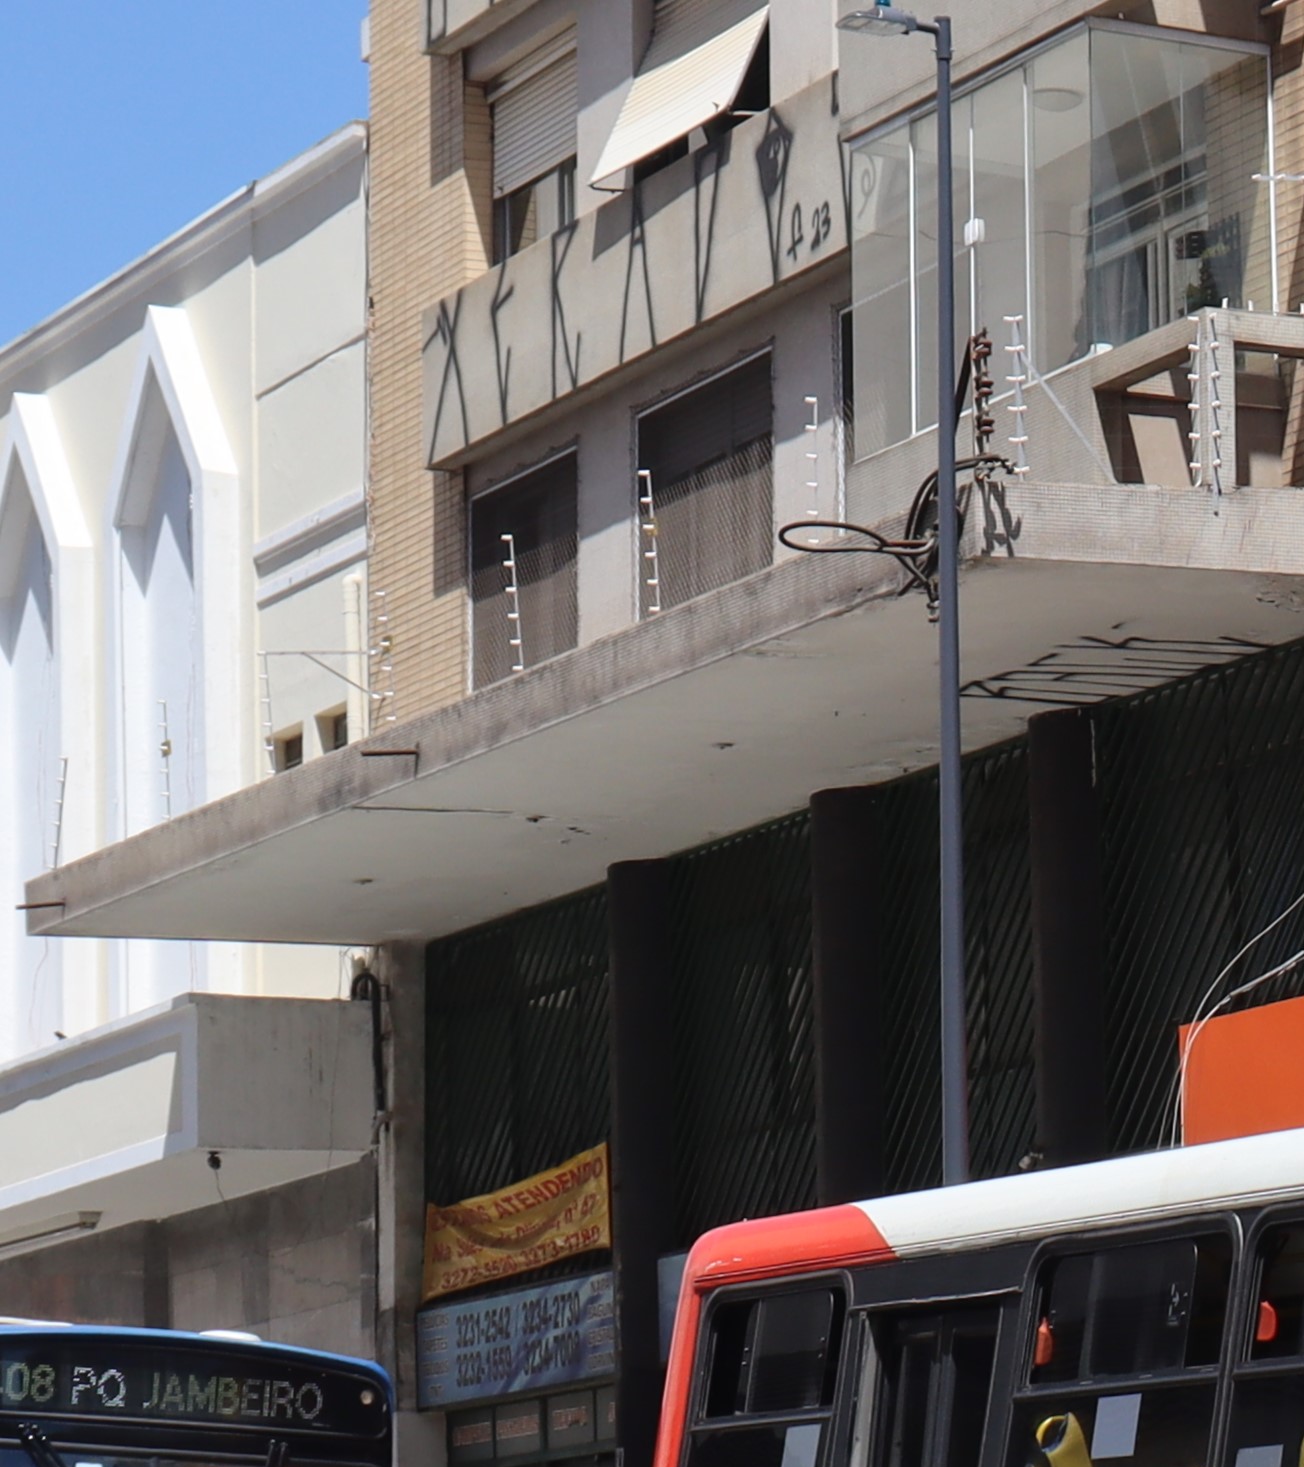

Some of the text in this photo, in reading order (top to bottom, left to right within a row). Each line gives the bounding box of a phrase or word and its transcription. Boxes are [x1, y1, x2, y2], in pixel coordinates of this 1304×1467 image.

[0, 1361, 324, 1420] 08 PQ JAMBEIRO
